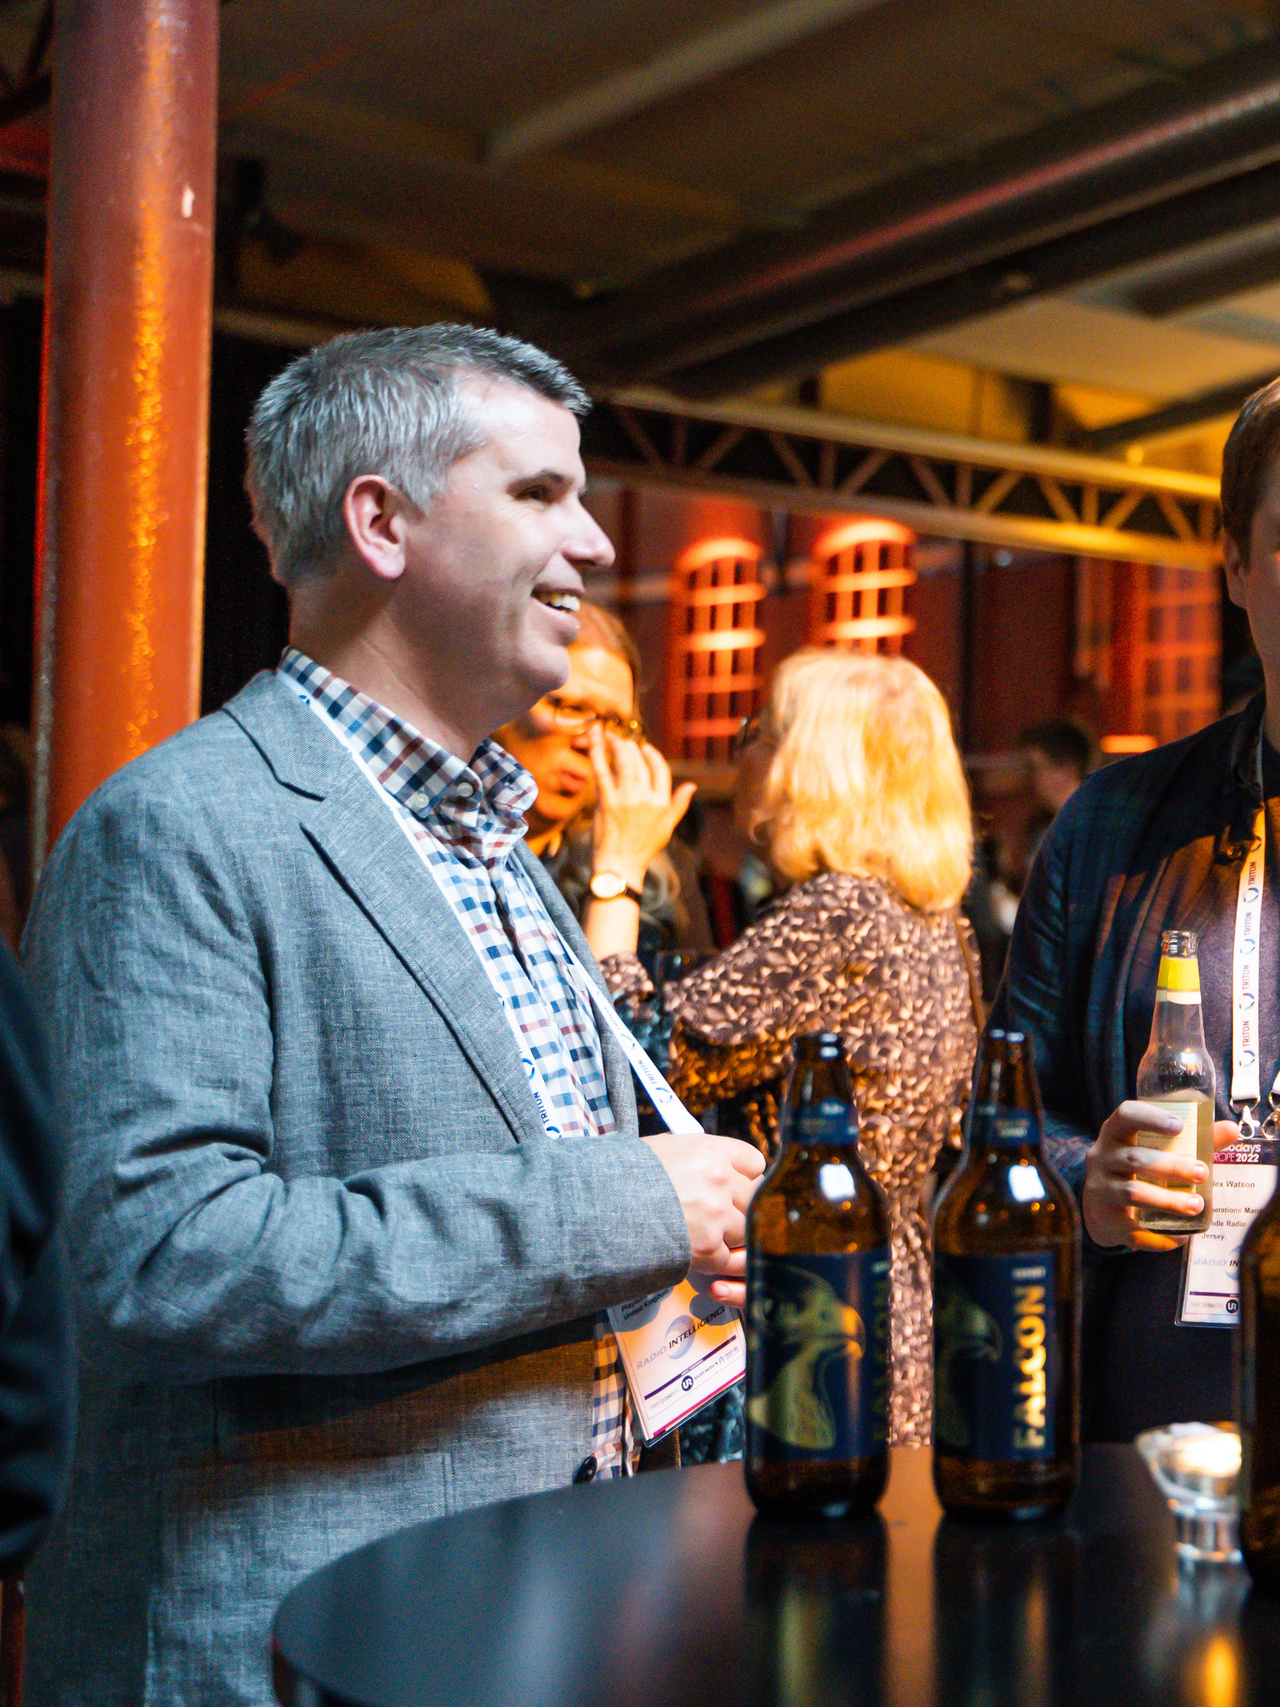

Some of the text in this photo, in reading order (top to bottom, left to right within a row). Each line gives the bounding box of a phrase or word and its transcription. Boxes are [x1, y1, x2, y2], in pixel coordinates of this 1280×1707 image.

[1248, 861, 1256, 885] TRITON
[1244, 912, 1252, 936] TRITON
[1242, 964, 1250, 990] TRITON
[1242, 1020, 1250, 1047] TRITON
[638, 1060, 658, 1085] TRITON
[1213, 1152, 1260, 1163] ROPE 2022
[1221, 1143, 1261, 1154] odays
[1212, 1180, 1256, 1188] lex Watson
[1212, 1206, 1242, 1214] erations
[1202, 1232, 1225, 1241] Jersey
[623, 1288, 670, 1320] United Kingdom
[1013, 1285, 1047, 1449] FALCON
